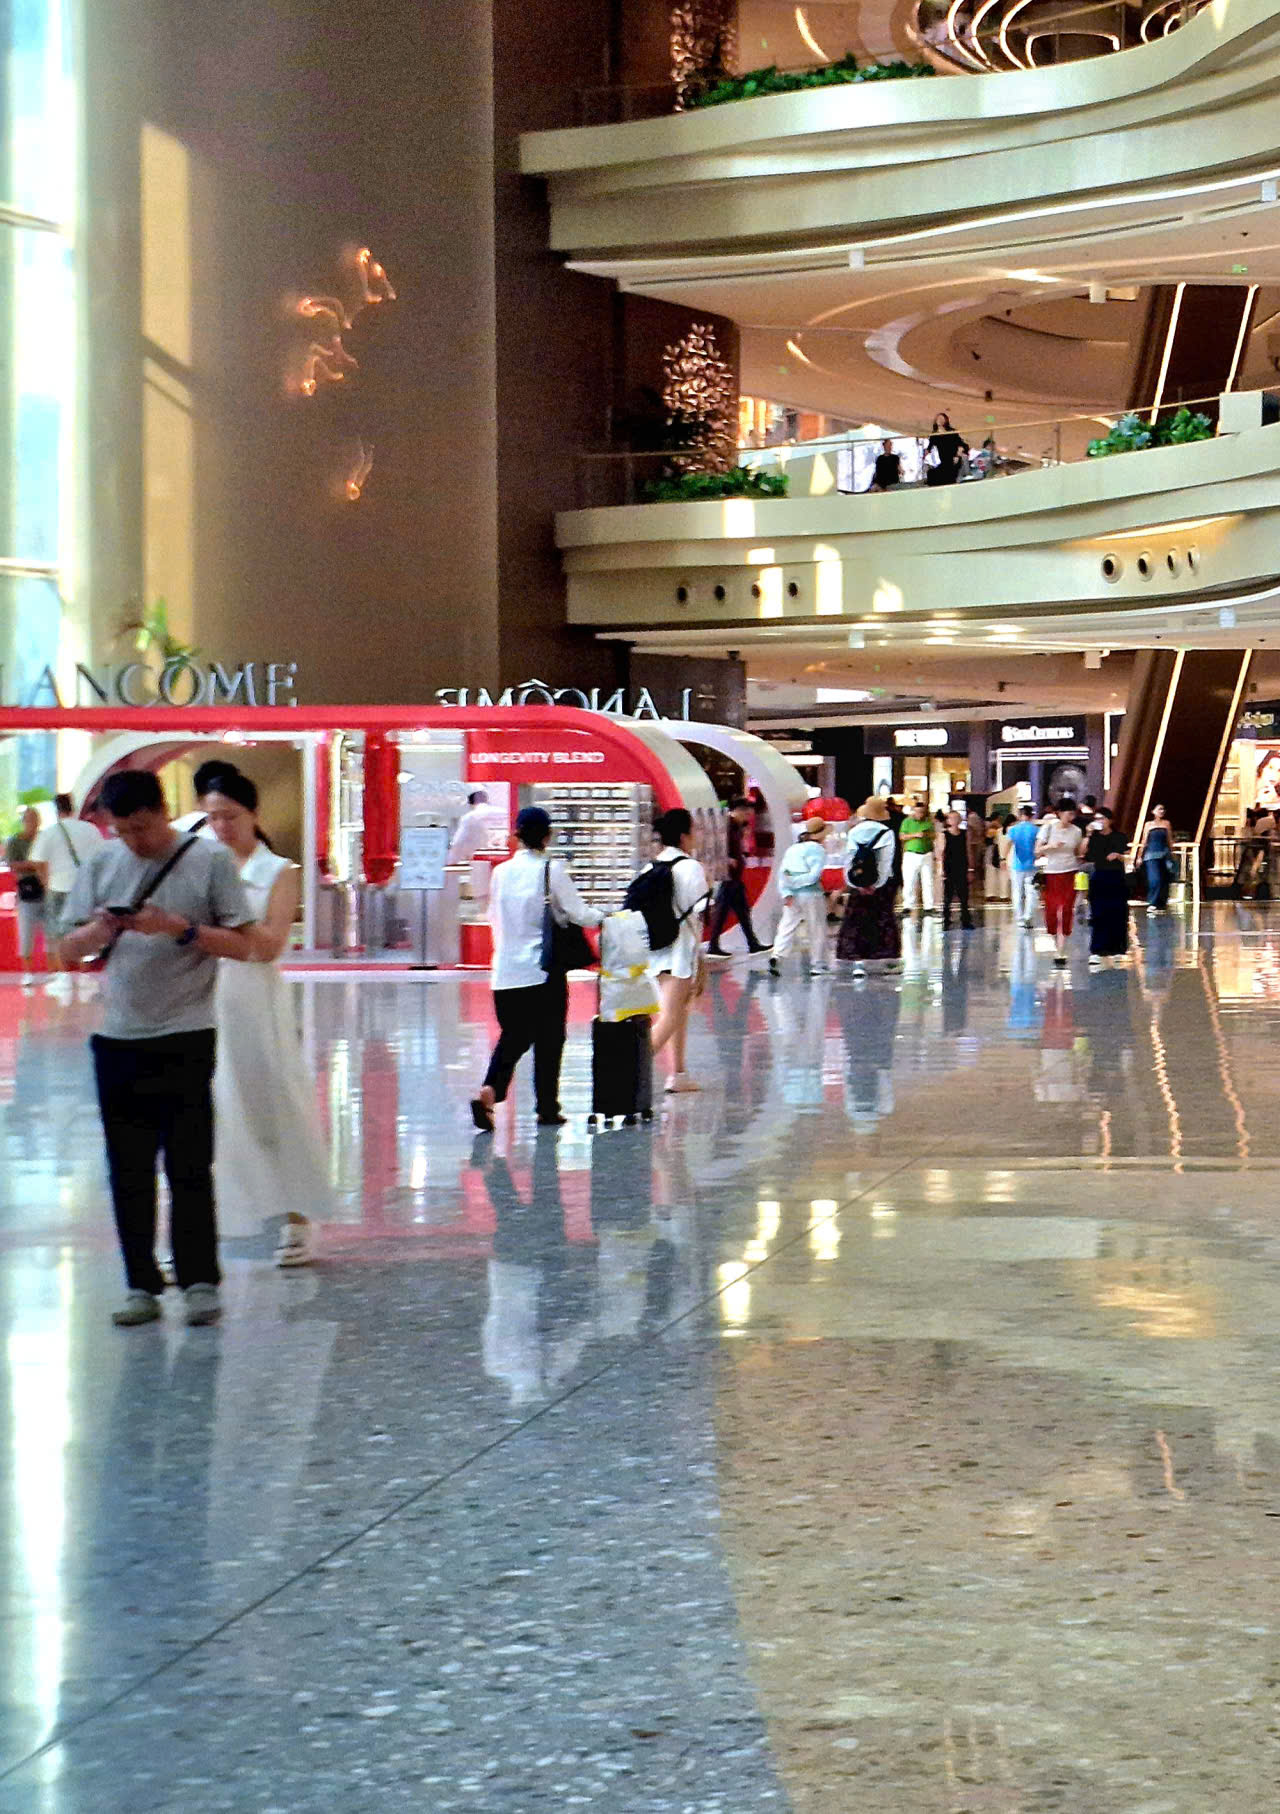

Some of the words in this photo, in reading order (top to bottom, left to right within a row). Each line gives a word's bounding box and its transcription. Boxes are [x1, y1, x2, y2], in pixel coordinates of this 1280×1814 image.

[0, 655, 298, 707] ANCÔME
[470, 751, 550, 764] LONGEVITY
[552, 751, 605, 764] BLEND
